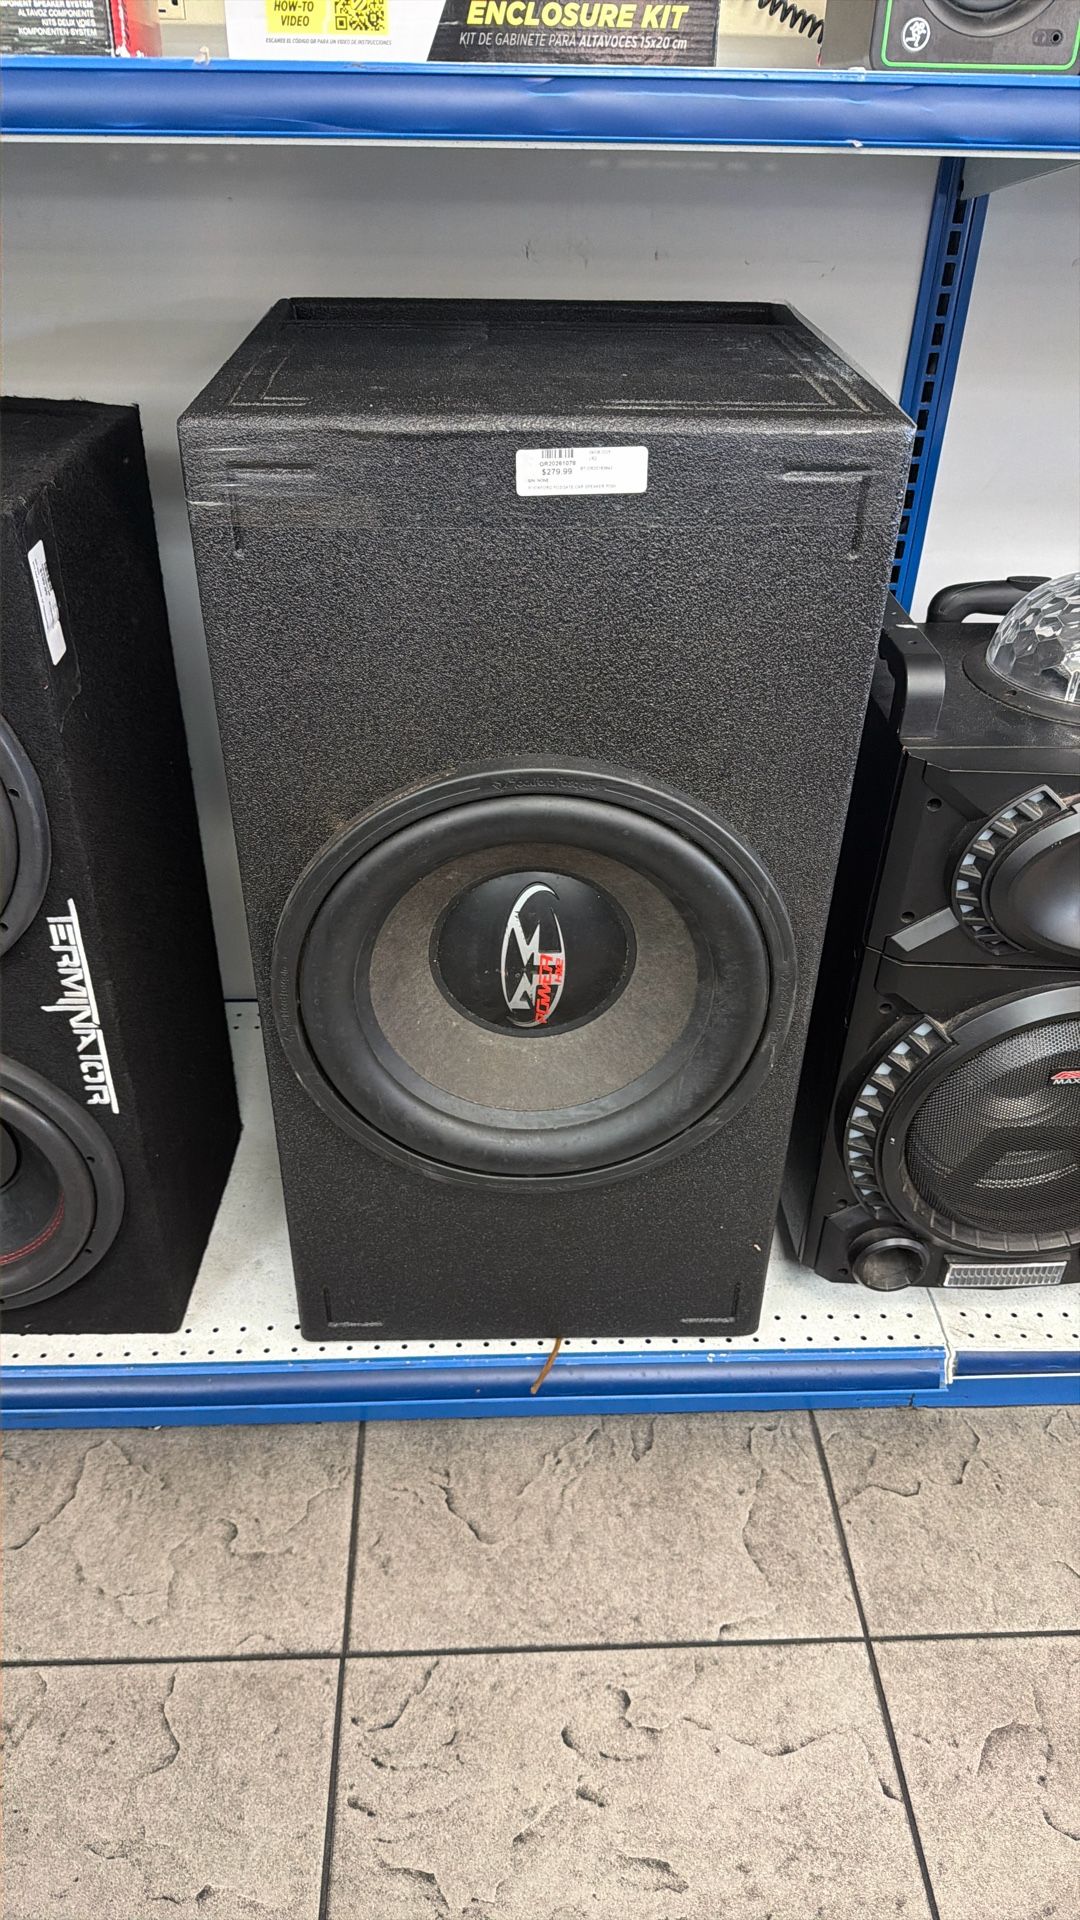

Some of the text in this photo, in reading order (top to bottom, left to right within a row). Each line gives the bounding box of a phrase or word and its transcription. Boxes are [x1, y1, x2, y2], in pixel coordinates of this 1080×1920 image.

[66, 0, 94, 8] SYSTEM
[273, 0, 315, 12] HOW-TO
[18, 8, 95, 18] ALTAVOZ COMPONENTE
[466, 0, 690, 29] ENCLOSURE KIT
[41, 18, 96, 28] KITS DEUX VOIES
[280, 15, 310, 27] VIDEO
[18, 27, 98, 37] KOMPONENTEN SYSTEM
[459, 32, 688, 50] KIT DE GABINETE PARA ALTAVOCES 15x20 cm
[542, 468, 573, 476] $279.99
[534, 953, 554, 1024] POWER
[41, 898, 120, 1115] TERMINATOR
